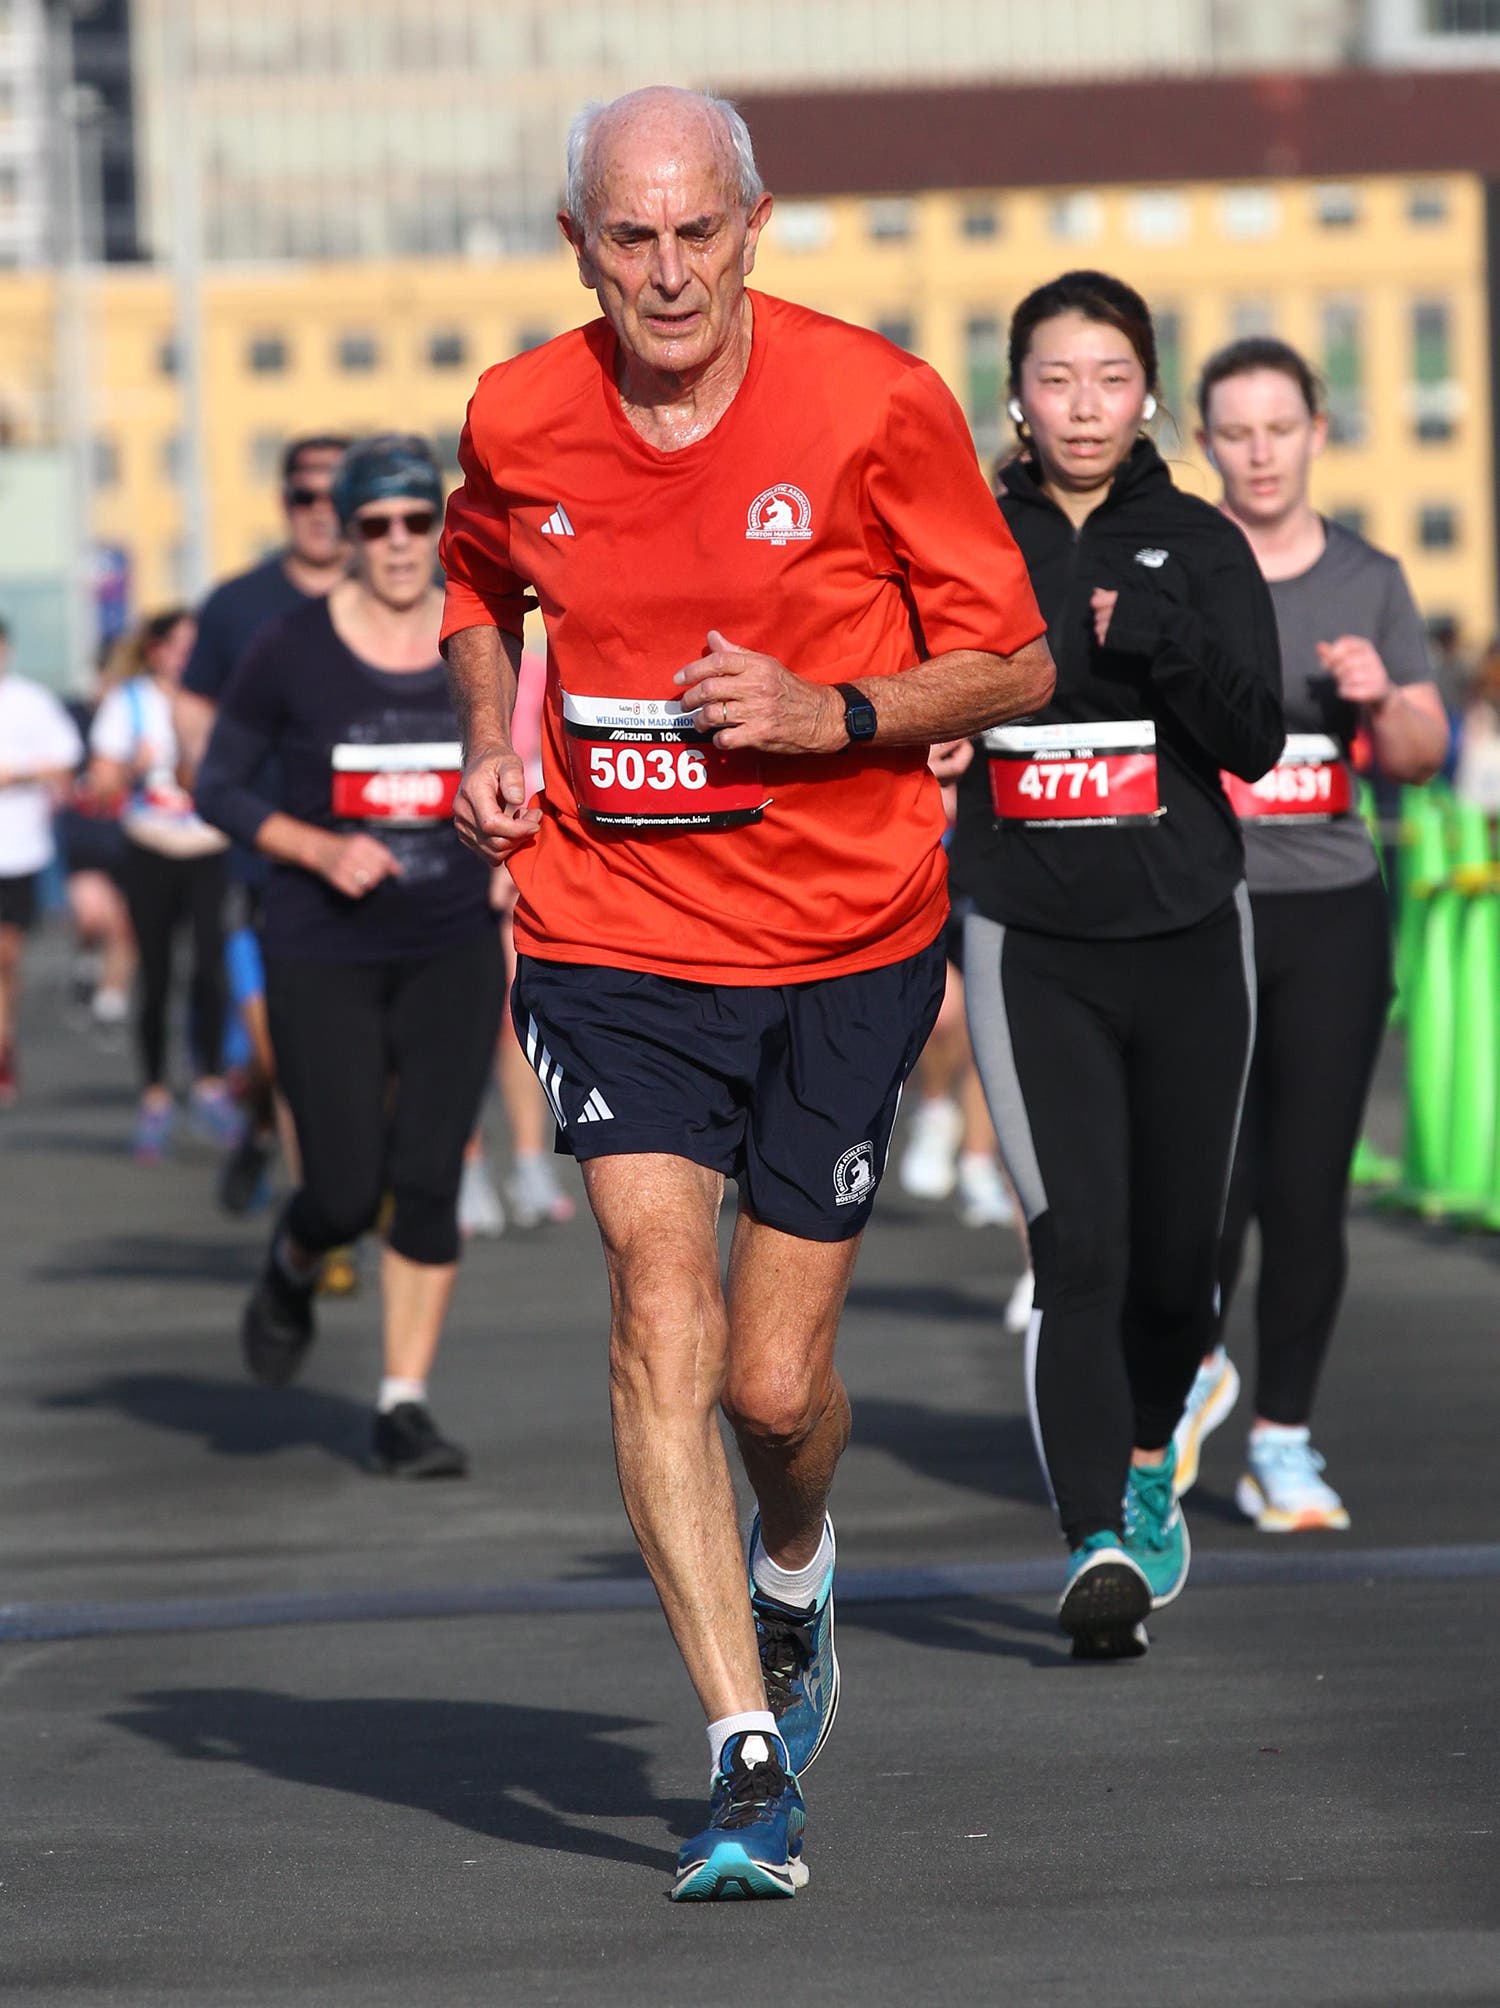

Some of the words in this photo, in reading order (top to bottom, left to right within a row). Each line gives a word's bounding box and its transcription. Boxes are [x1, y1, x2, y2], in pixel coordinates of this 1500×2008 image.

[596, 715, 646, 726] WELLINGTON
[660, 732, 682, 742] 10K
[590, 747, 707, 790] 5036
[1018, 760, 1109, 800] 4771
[596, 815, 711, 826] www.wellingtonmarathon.kiwi
[836, 1163, 845, 1192] BOSTON
[835, 1191, 859, 1204] BOSTON
